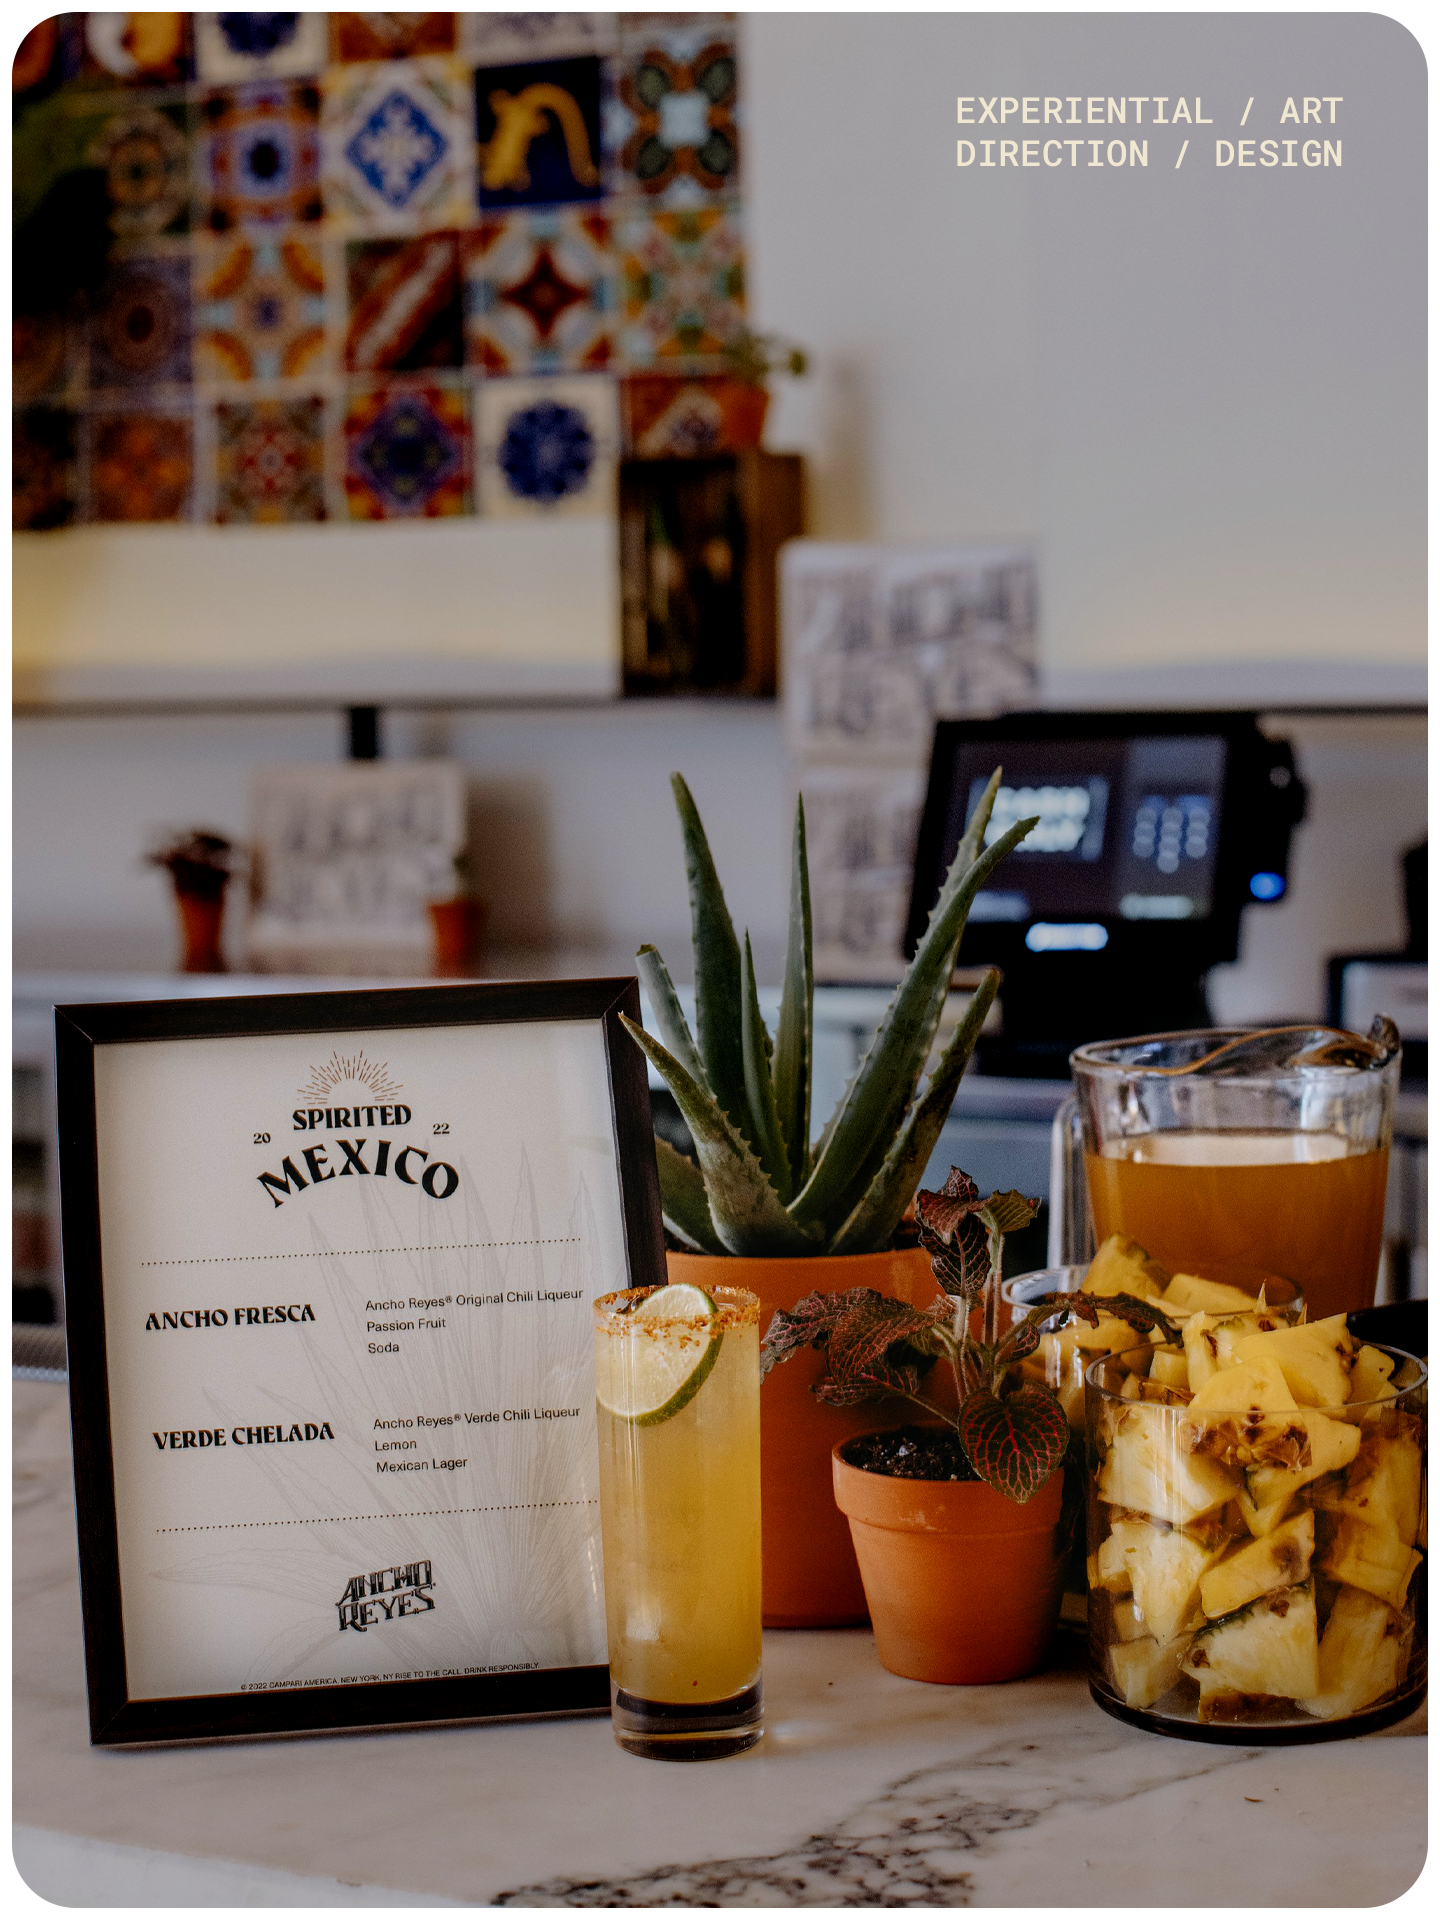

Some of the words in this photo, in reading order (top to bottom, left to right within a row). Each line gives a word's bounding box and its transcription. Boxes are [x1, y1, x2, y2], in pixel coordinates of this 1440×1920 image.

[292, 1104, 412, 1131] SPIRITED
[433, 1123, 450, 1135] 22
[253, 1132, 271, 1144] 20
[256, 1138, 459, 1208] MEXICO
[365, 1300, 406, 1312] Ancho
[455, 1292, 504, 1307] Original
[506, 1290, 534, 1303] Chili
[537, 1288, 584, 1301] Liqueur
[145, 1308, 229, 1331] ANCHO
[234, 1304, 316, 1326] FRESCA
[366, 1320, 415, 1333] Passion
[418, 1317, 447, 1330] Fruit
[367, 1341, 400, 1354] Soda
[373, 1417, 414, 1430] Ancho
[463, 1411, 500, 1424] Verde
[503, 1409, 531, 1421] Chili
[533, 1406, 581, 1421] Liqueur
[152, 1428, 227, 1450] VERDE
[231, 1421, 335, 1446] CHELADA
[374, 1439, 417, 1452] Lemon
[376, 1459, 429, 1473] Mexican
[432, 1457, 468, 1472] Lager
[335, 1559, 433, 1606] ANCHO
[337, 1583, 436, 1632] REYES
[248, 1682, 268, 1690] 2022
[269, 1680, 303, 1689] CAMPARI
[340, 1676, 358, 1684] NEW
[395, 1671, 412, 1679] RISE
[426, 1669, 441, 1677] THE
[464, 1666, 487, 1675] DRINK
